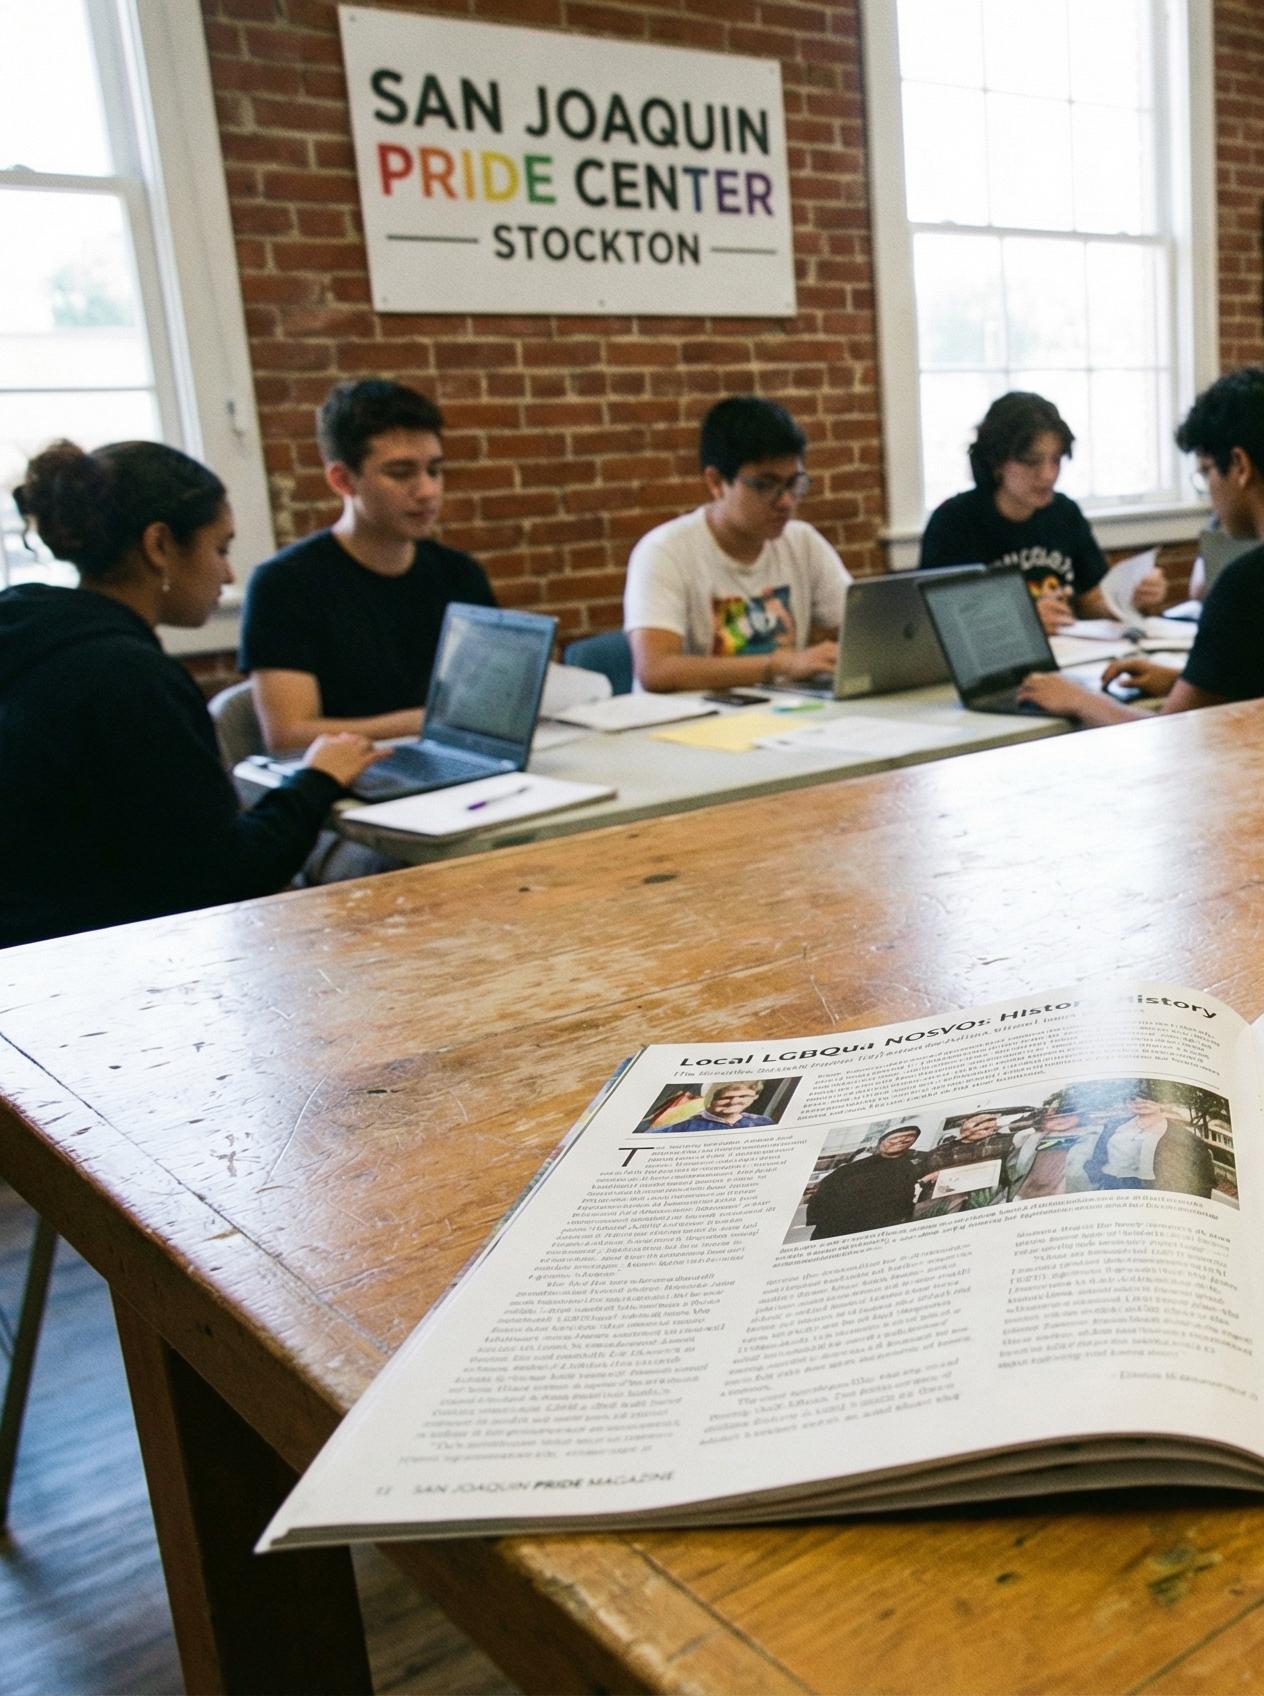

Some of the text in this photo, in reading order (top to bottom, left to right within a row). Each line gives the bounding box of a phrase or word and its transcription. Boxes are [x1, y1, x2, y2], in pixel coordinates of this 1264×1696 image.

[370, 68, 770, 156] SAN JOAQUIN
[377, 143, 774, 217] PRIDE CENTER
[493, 224, 700, 266] STOCKTON
[680, 1054, 753, 1067] Local
[533, 1477, 583, 1491] PRIDE
